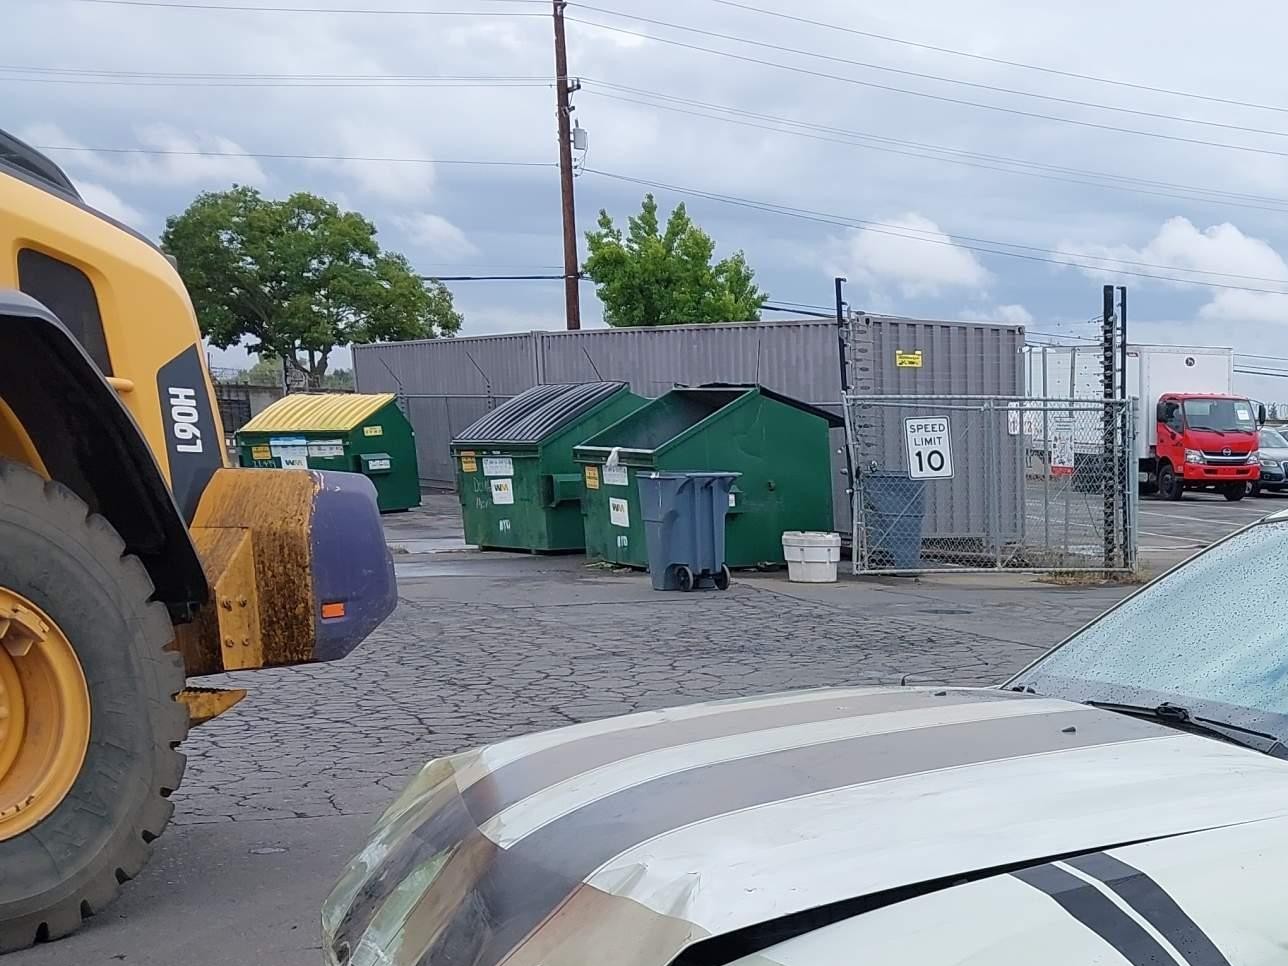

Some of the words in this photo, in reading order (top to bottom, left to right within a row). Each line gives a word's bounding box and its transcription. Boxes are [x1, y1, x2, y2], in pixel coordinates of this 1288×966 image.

[168, 387, 203, 453] L90H
[909, 423, 946, 433] SPEED
[914, 436, 943, 447] LIMIT
[915, 449, 945, 472] 10
